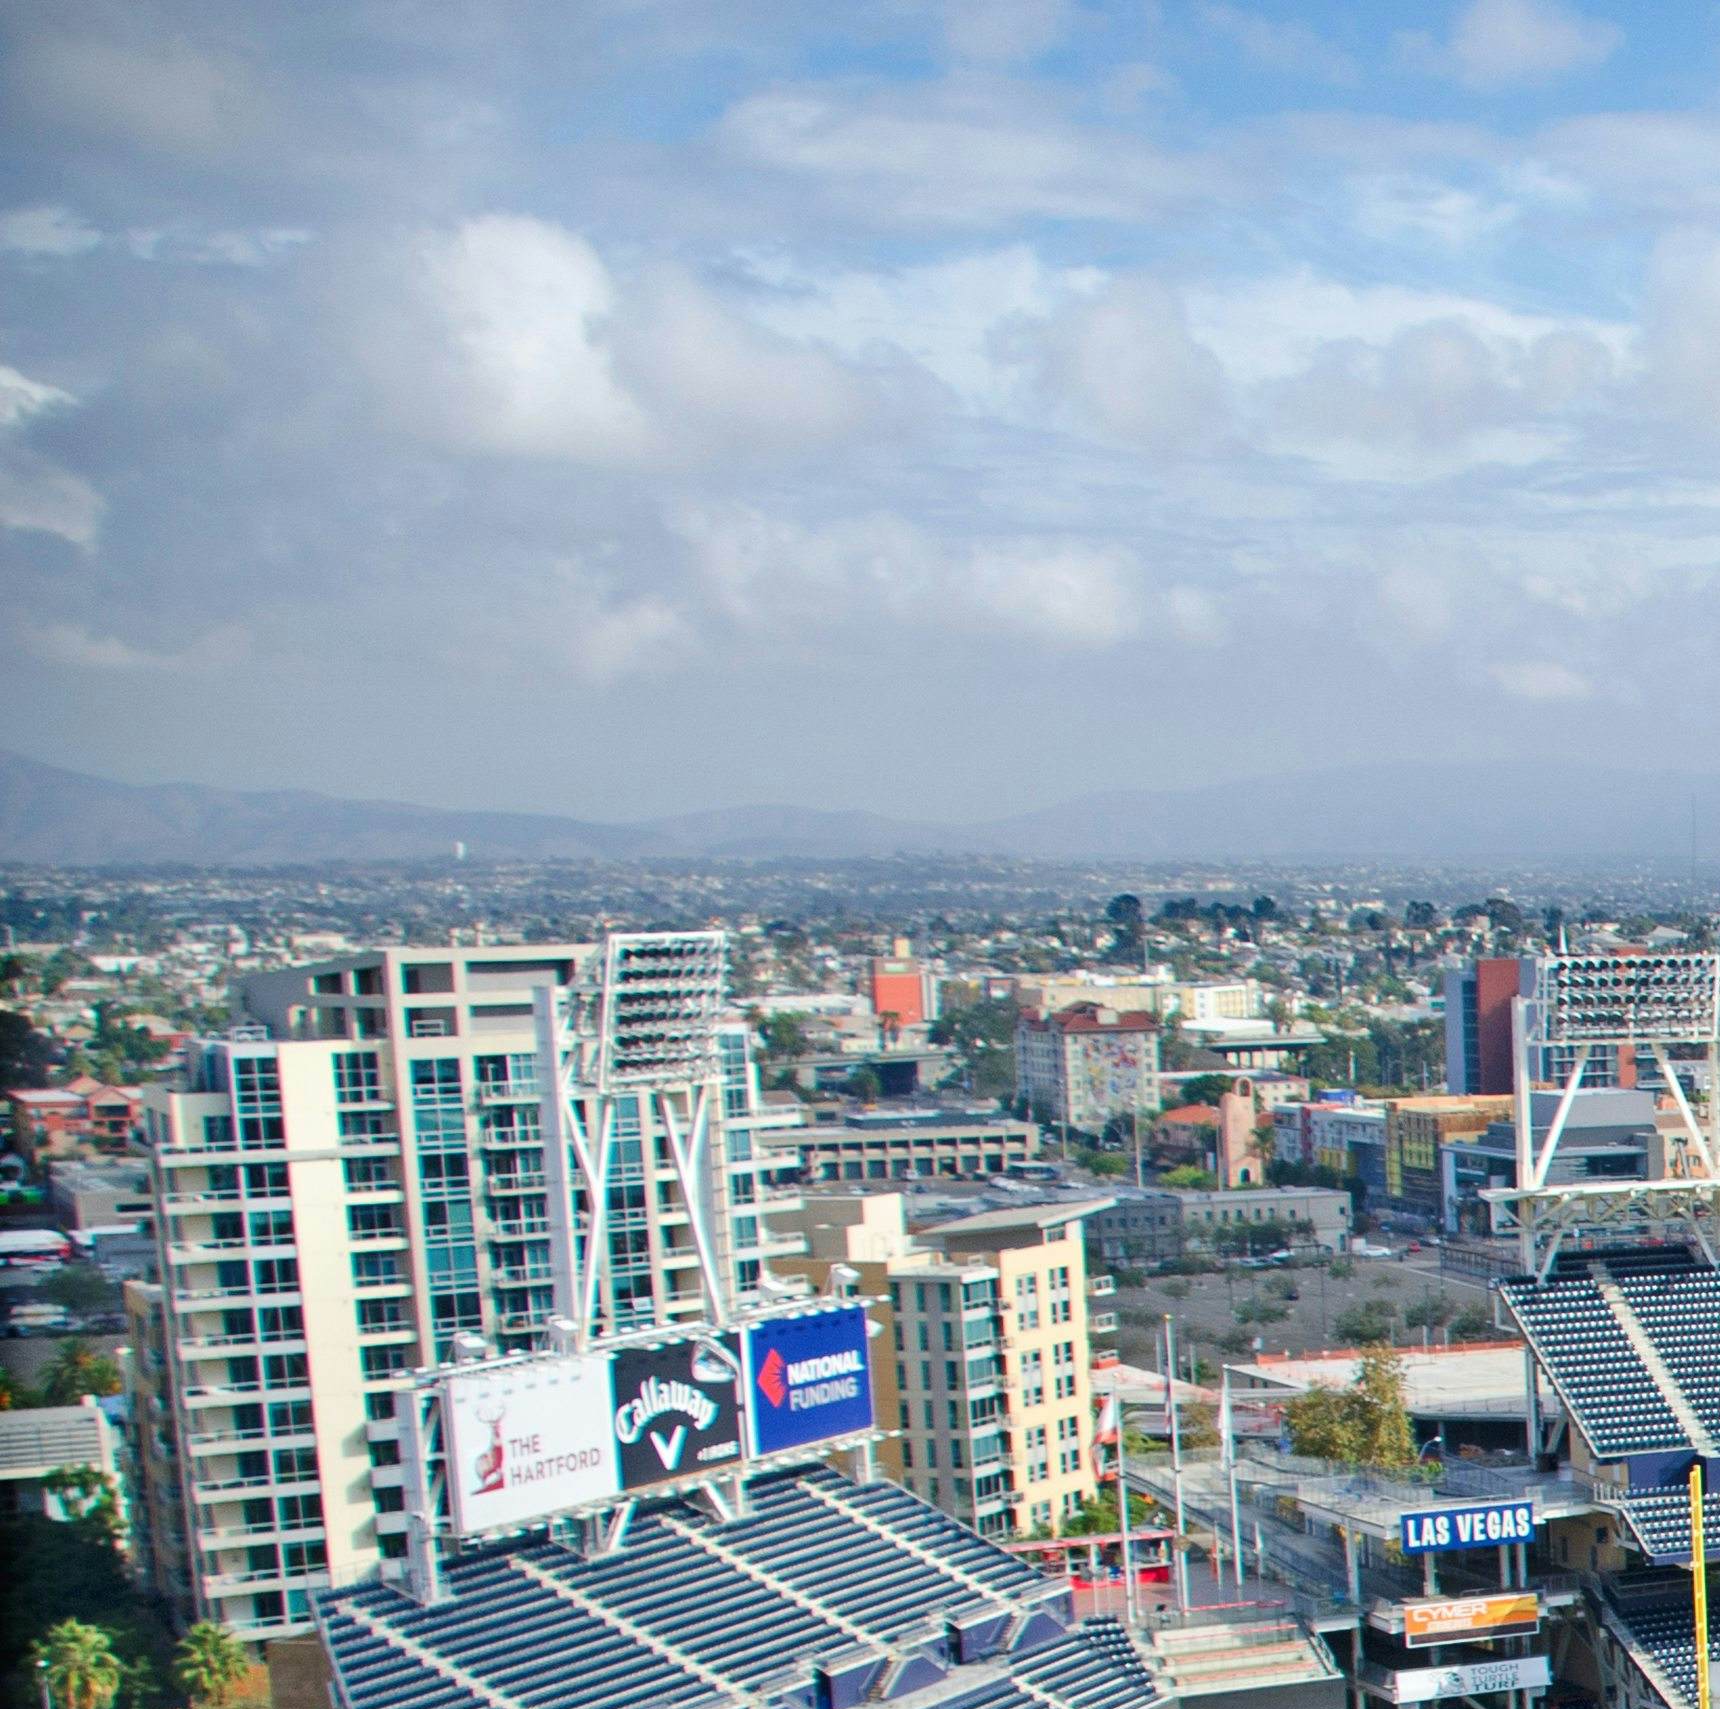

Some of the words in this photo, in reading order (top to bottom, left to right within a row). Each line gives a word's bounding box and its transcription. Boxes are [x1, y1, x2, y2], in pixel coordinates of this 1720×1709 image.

[786, 1350, 866, 1382] NATIONAL
[790, 1378, 859, 1410] FUNDING
[615, 1375, 720, 1444] Callaway
[509, 1434, 541, 1458] THE
[511, 1447, 602, 1487] HARTFORD
[1407, 1516, 1450, 1548] LAS
[1455, 1507, 1530, 1543] VEGAS
[1412, 1601, 1489, 1623] CYMER
[1471, 1663, 1519, 1675] TOUGH
[1472, 1673, 1519, 1684] TURTLE
[1473, 1681, 1519, 1692] TURF
